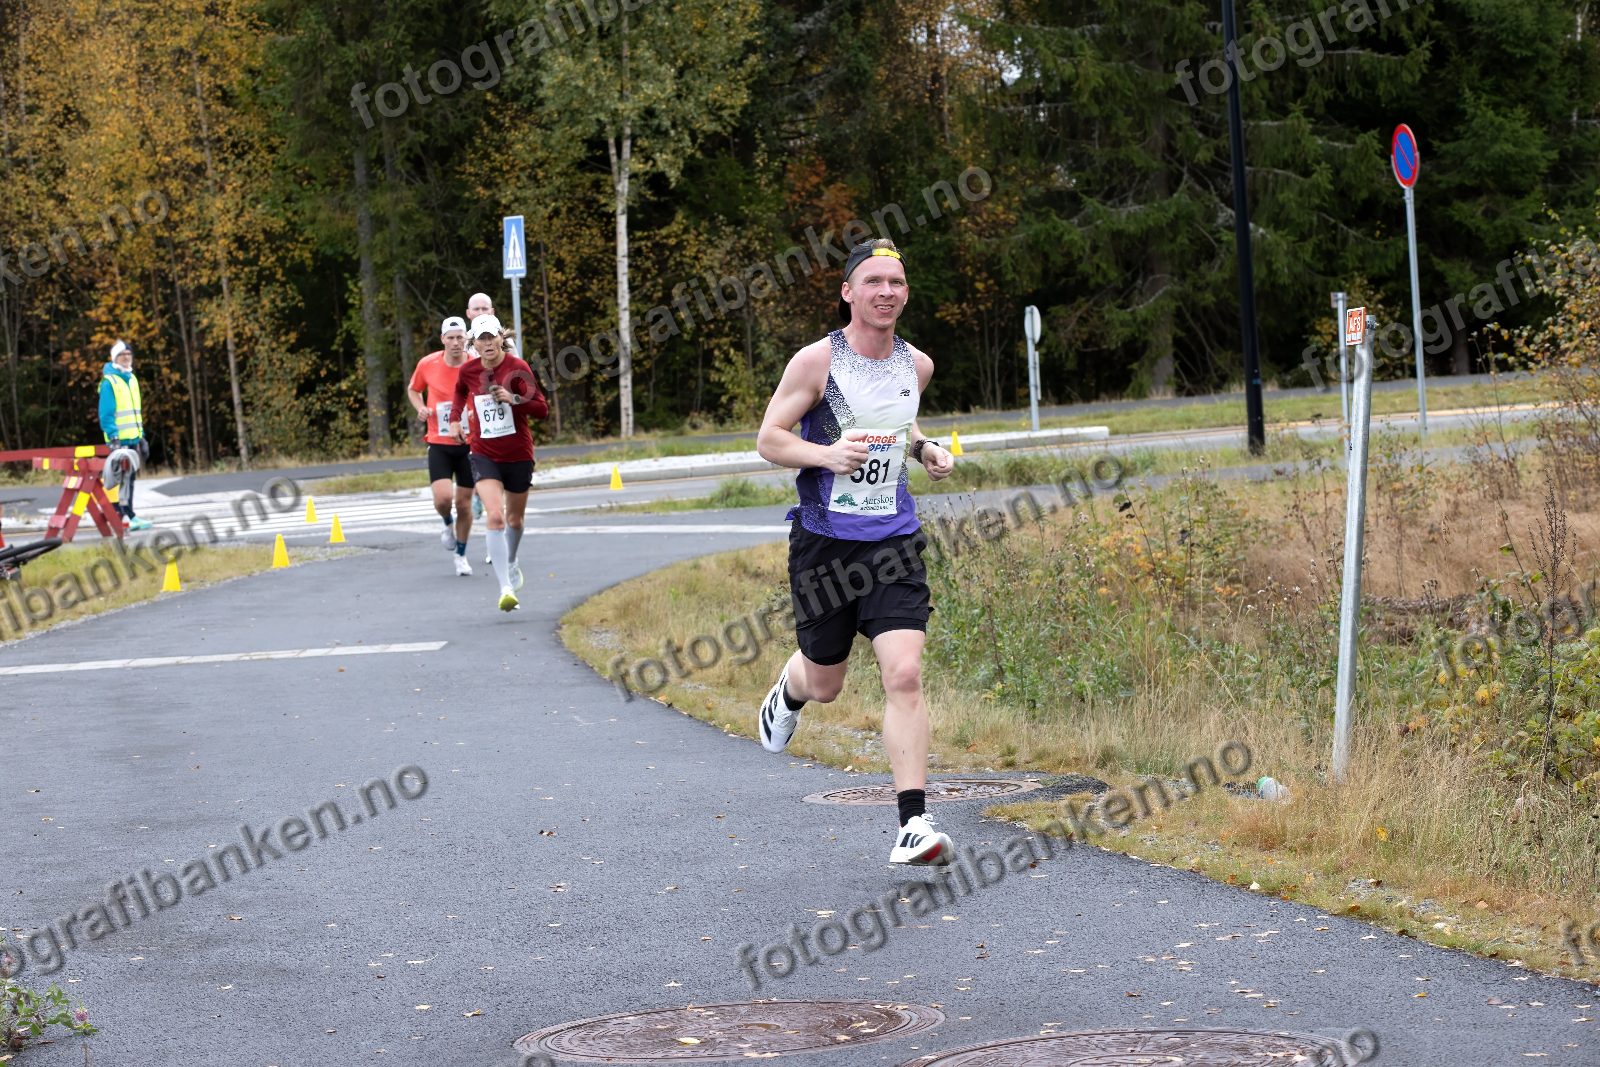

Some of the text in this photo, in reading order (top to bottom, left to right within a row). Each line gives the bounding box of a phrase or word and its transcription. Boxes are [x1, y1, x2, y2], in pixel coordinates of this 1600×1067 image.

[484, 408, 505, 423] 679
[867, 444, 893, 453] ØPET
[850, 459, 891, 485] 581
